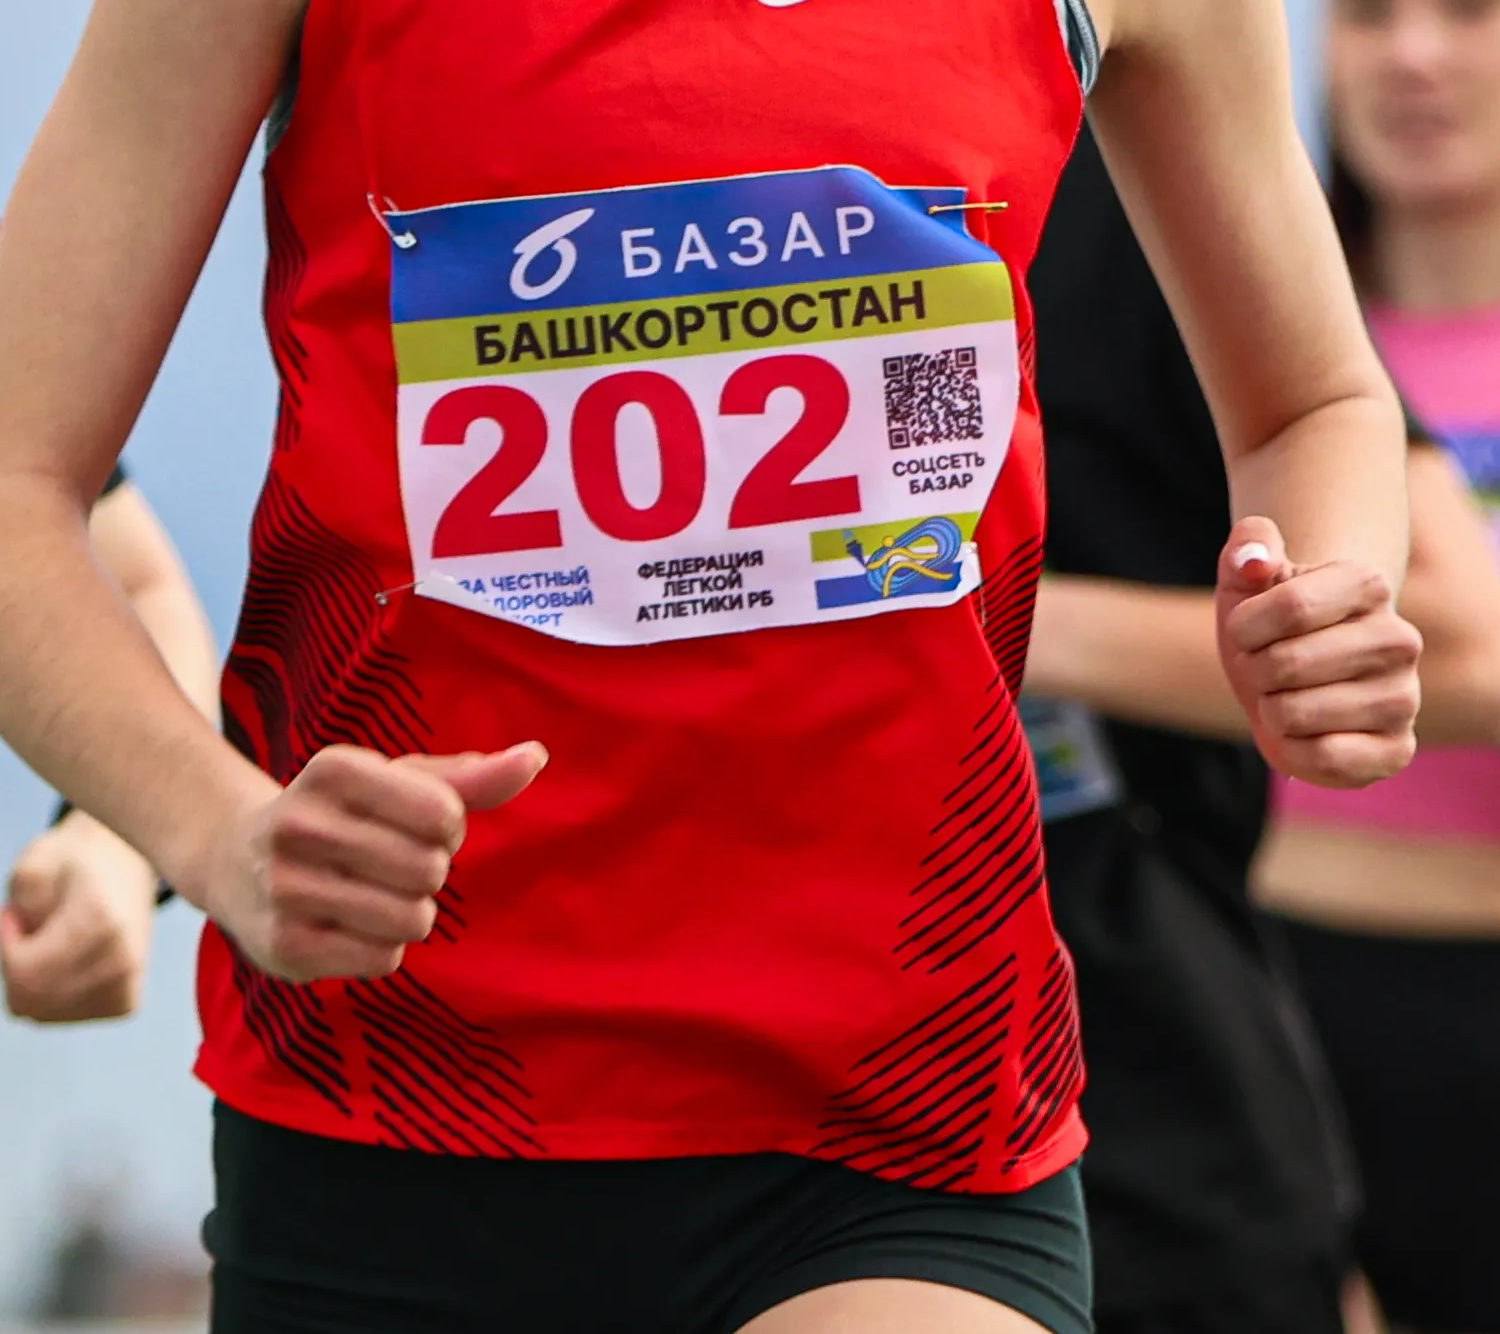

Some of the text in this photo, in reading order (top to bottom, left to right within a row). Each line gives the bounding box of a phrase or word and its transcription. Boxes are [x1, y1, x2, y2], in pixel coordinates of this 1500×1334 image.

[621, 205, 875, 278] БАЗАР
[475, 281, 926, 366] БАШКОРТОСТАН
[421, 353, 862, 559] 202
[892, 452, 985, 476] СОЦСЕТЬ
[909, 473, 973, 495] БАЗАР
[638, 550, 764, 579] ФЕДЕРАЦИЯ
[490, 565, 590, 593] ЧЕСТНЫЙ
[662, 572, 742, 598] ЛЕГКОЙ
[486, 585, 594, 613] ДОРОВЫЙ
[636, 590, 774, 622] АТЛЕТИКИ РБ
